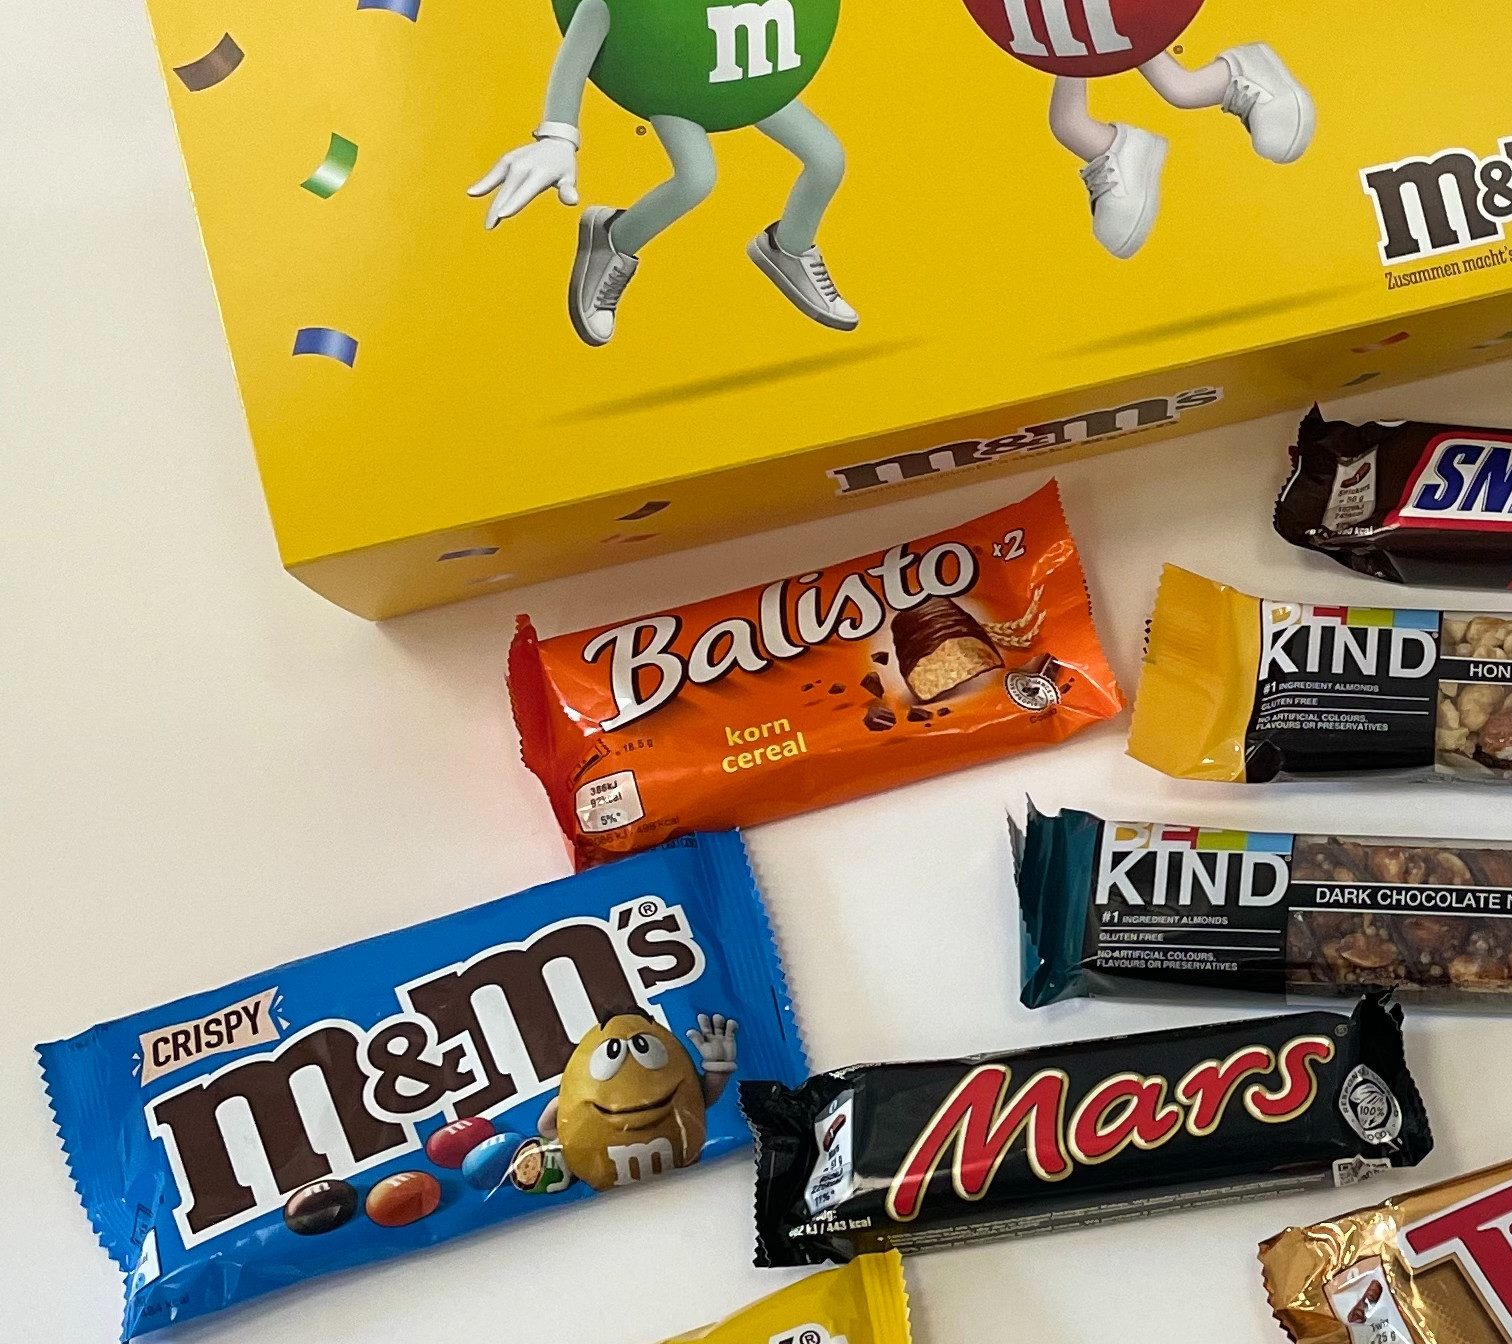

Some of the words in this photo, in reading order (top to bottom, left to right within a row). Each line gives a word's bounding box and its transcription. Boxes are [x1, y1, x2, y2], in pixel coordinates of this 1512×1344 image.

[707, 1, 801, 84] m
[1385, 263, 1461, 290] Zusammen
[993, 528, 1025, 561] x2
[584, 541, 980, 733] Balisto
[1259, 617, 1437, 680] KIND
[1263, 681, 1277, 694] #1
[1279, 682, 1333, 692] INGREDIENT
[1335, 683, 1379, 693] ALMONDS
[1261, 697, 1294, 710] GLUTEN
[1295, 697, 1319, 706] FREE
[726, 715, 791, 746] korn
[1256, 721, 1301, 731] FLAVOURS
[1303, 722, 1315, 730] OR
[1317, 722, 1389, 732] PRESERVATIVES
[1258, 715, 1271, 724] NO
[1273, 714, 1320, 723] ARTIFICIAL
[721, 734, 808, 773] cereal
[1095, 849, 1290, 907] KIND
[1315, 887, 1372, 906] DARK
[1377, 889, 1501, 910] CHOCOLATE
[1101, 911, 1120, 924] #1
[1122, 915, 1180, 925] INGREDIENT
[1182, 916, 1228, 925] ALMONDS
[1099, 933, 1137, 942] GLUTEN
[1139, 933, 1164, 942] FREE
[1097, 950, 1111, 960] NO
[1113, 950, 1165, 960] ARTIFICIAL
[1097, 959, 1146, 970] FLAVOURS
[1148, 961, 1161, 970] OR
[1163, 961, 1238, 971] PRESERVATIVES
[151, 1001, 265, 1069] CRISPY
[157, 907, 702, 1235] m&m's
[888, 1038, 1335, 1219] Mars
[607, 1138, 674, 1185] m
[827, 1221, 847, 1232] 443
[850, 1217, 872, 1229] kcal
